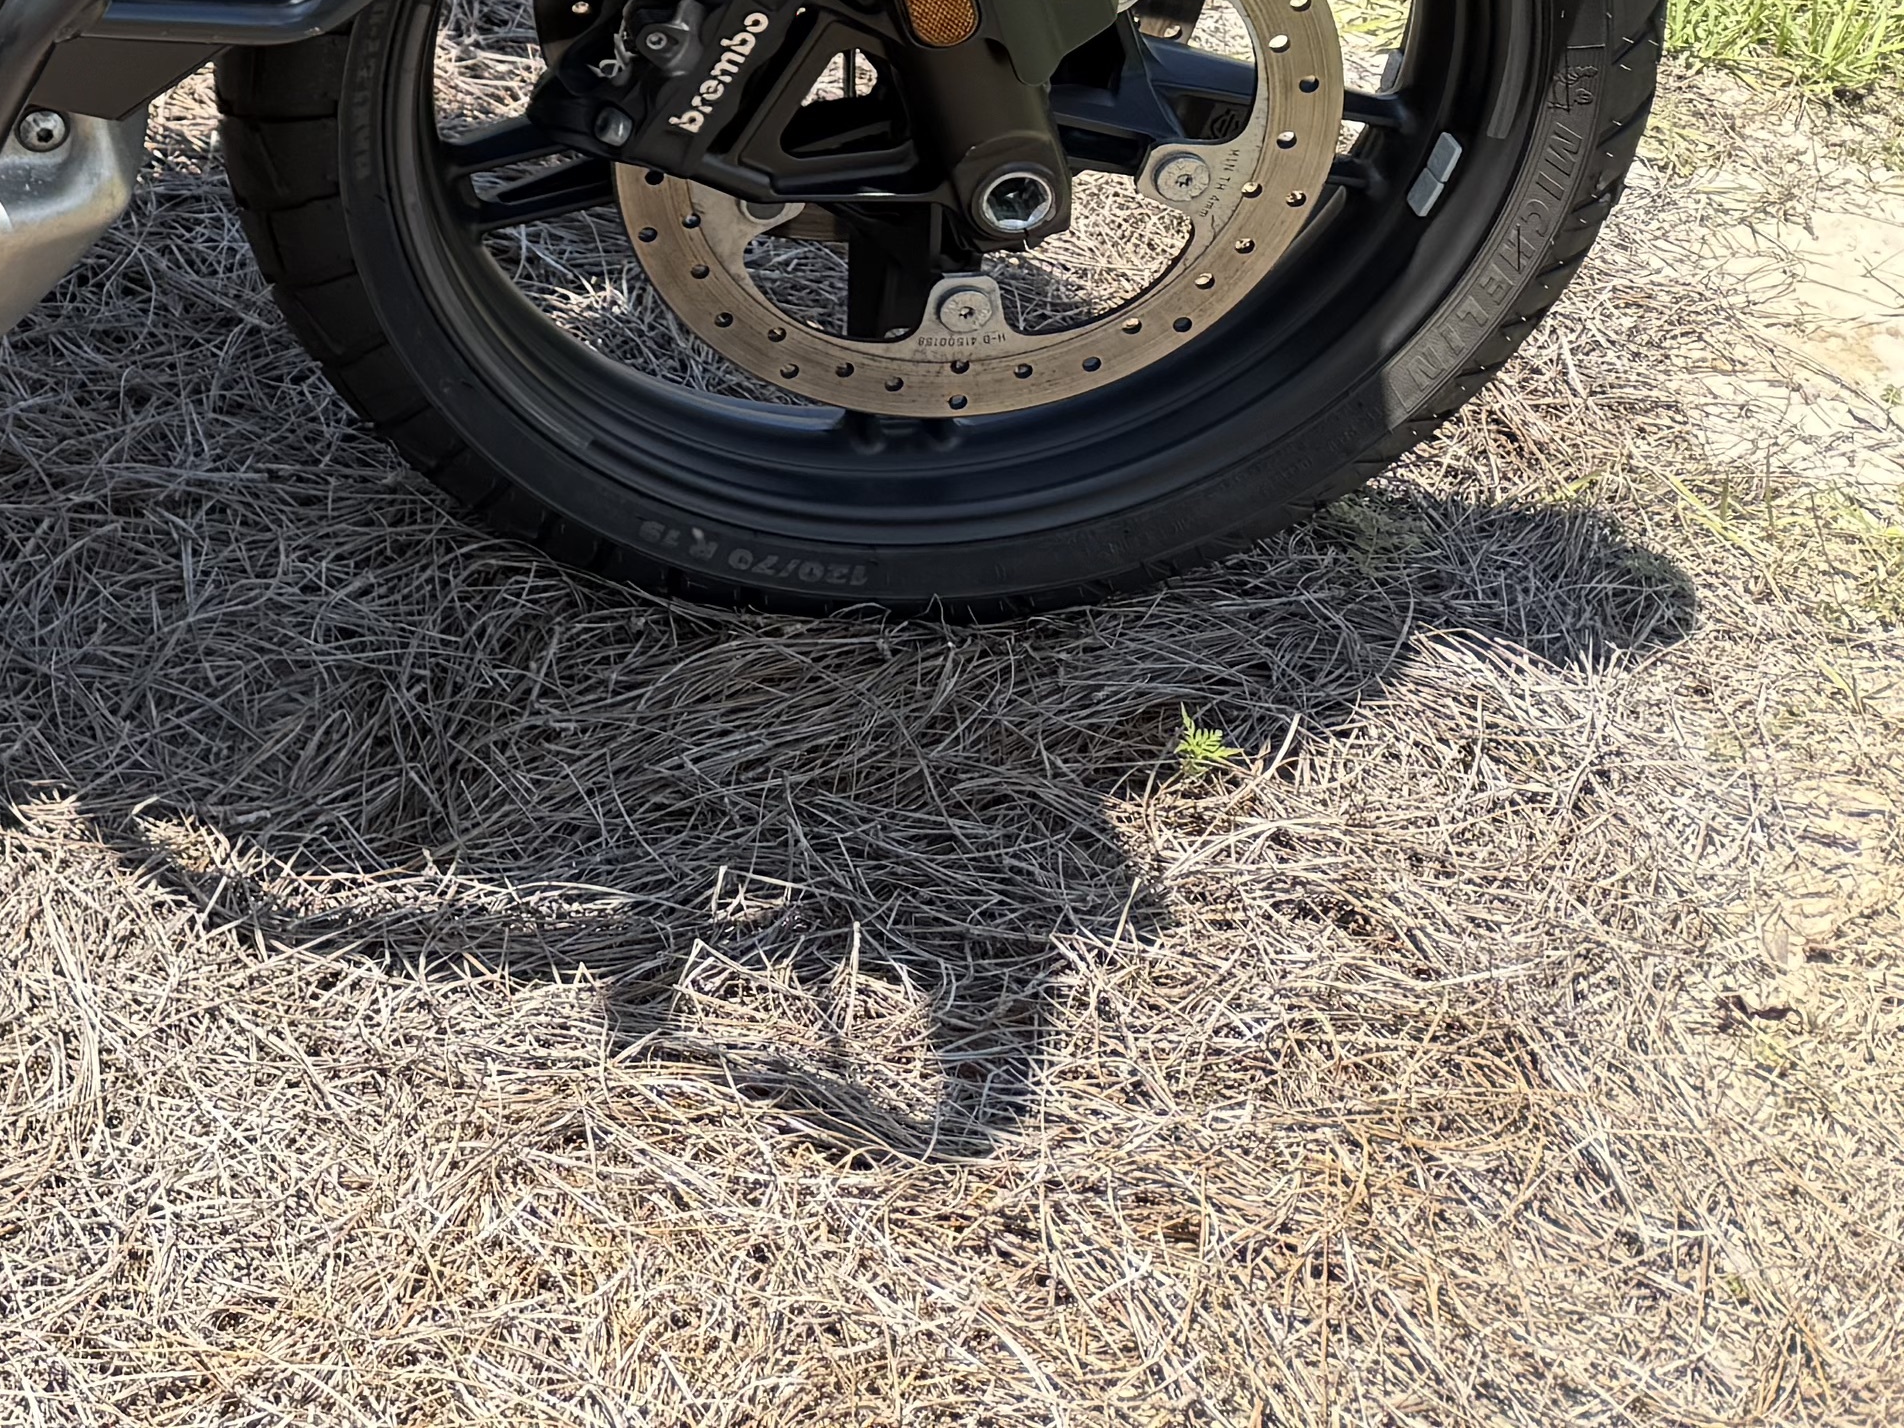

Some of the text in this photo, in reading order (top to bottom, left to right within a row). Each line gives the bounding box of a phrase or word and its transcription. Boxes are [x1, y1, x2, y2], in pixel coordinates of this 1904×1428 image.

[668, 12, 769, 133] brembo
[1406, 121, 1583, 392] MICHELIN
[727, 547, 869, 588] 120/70
